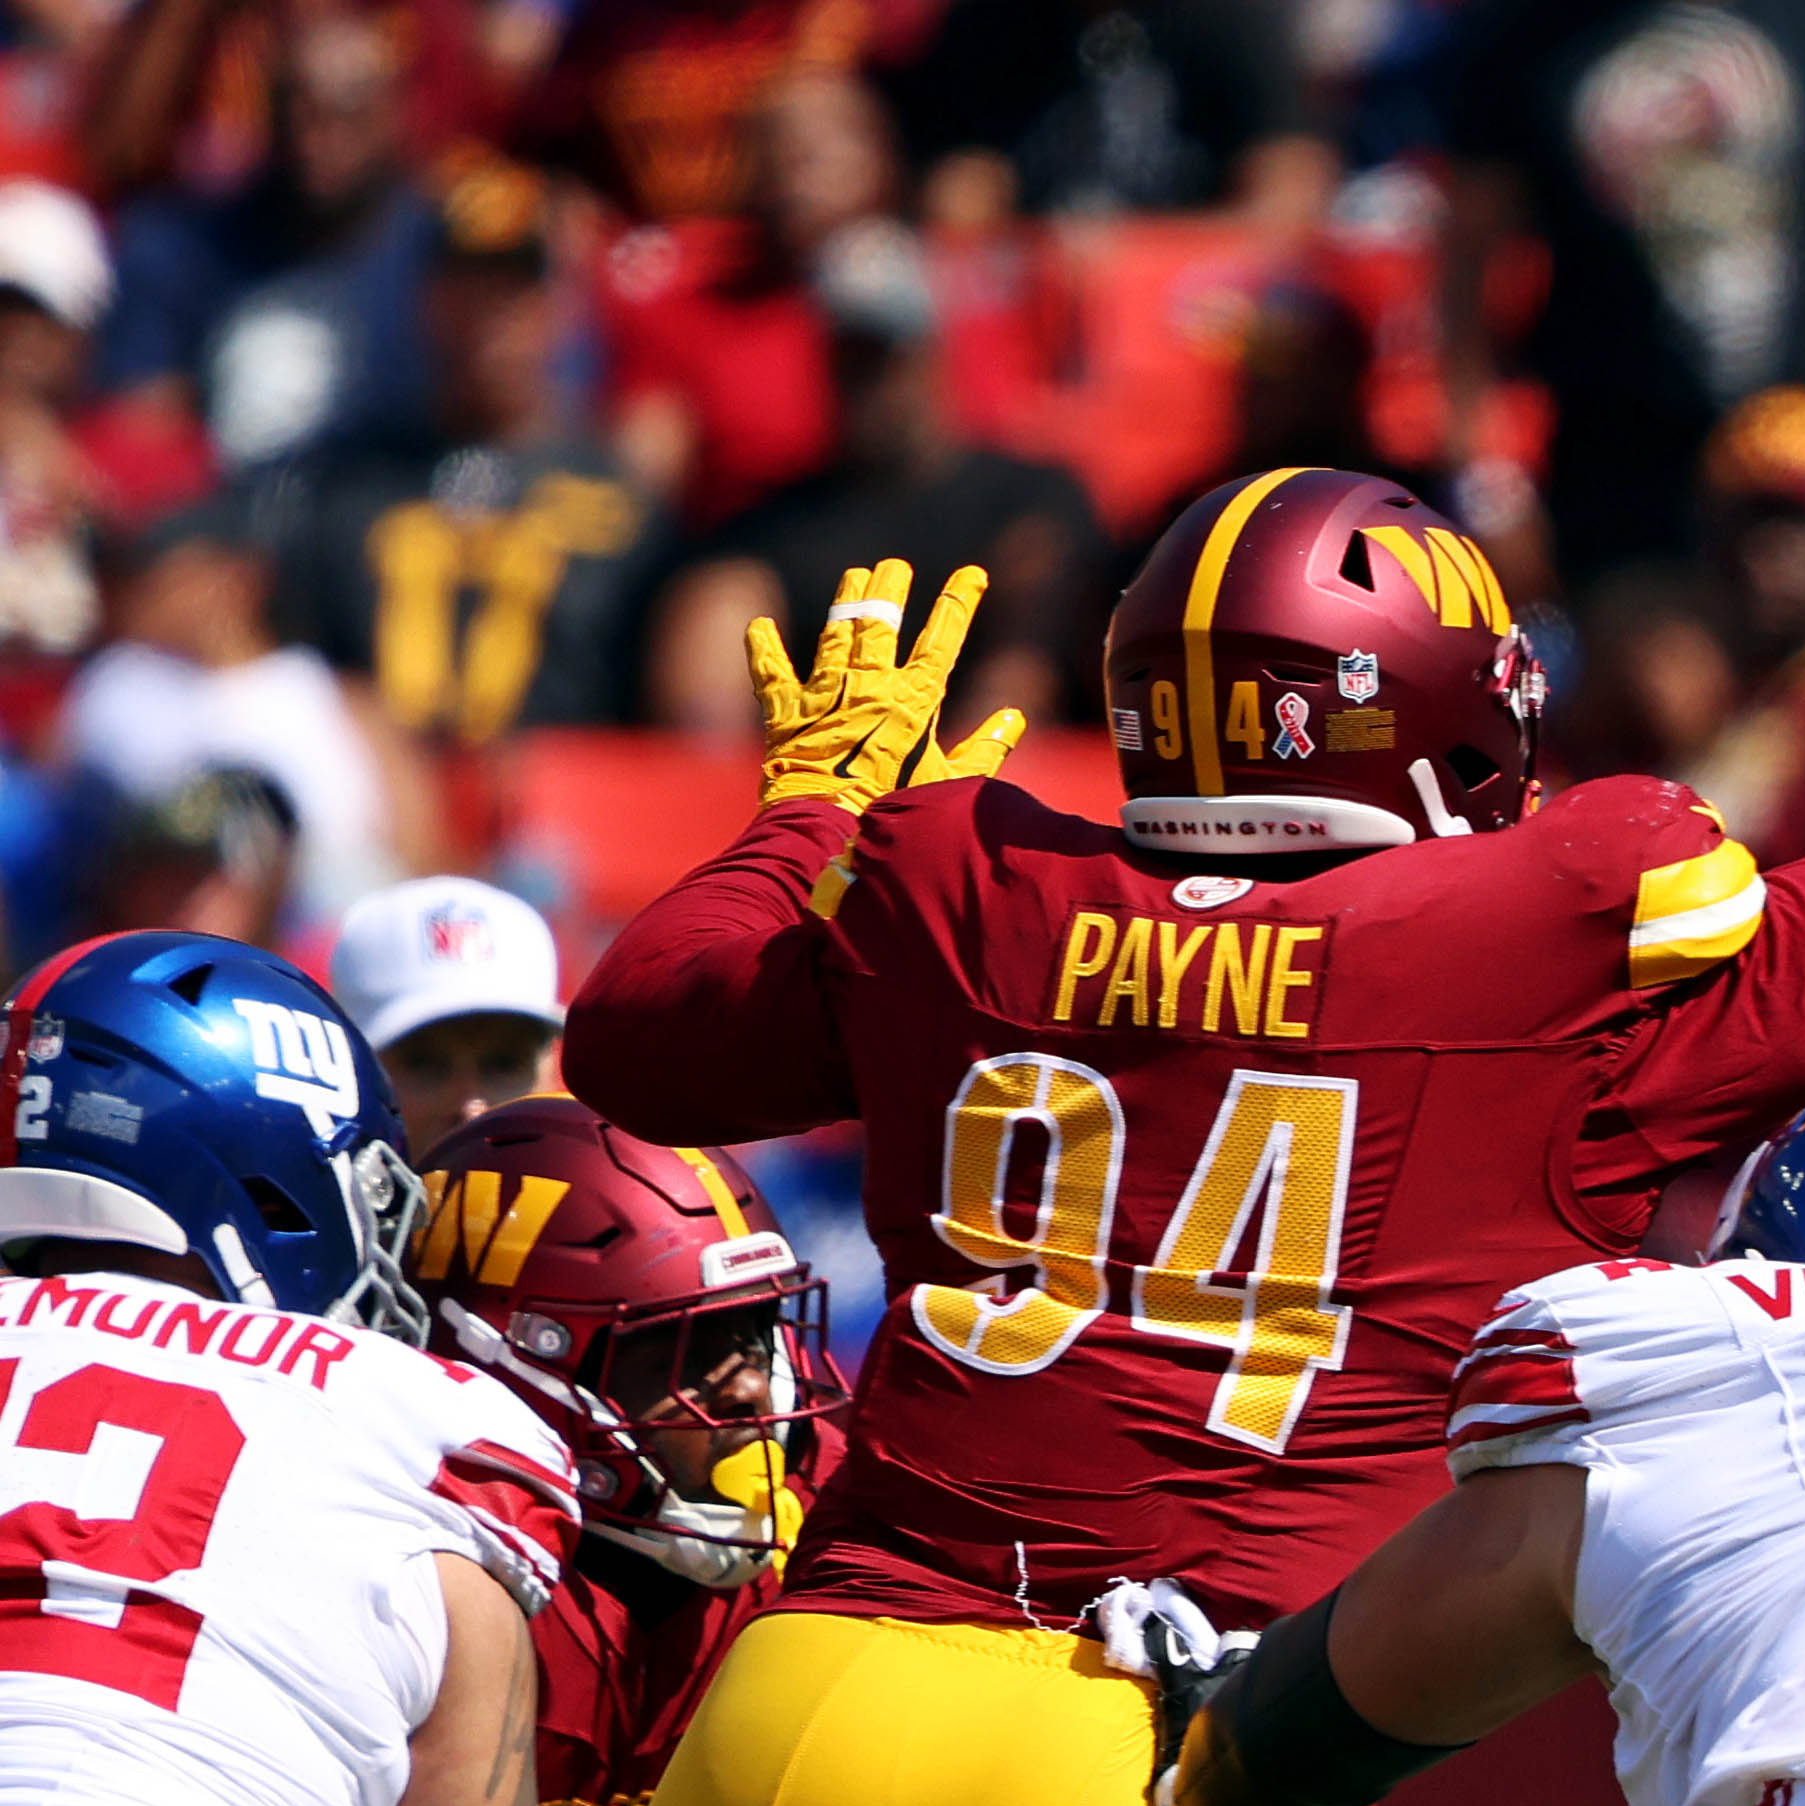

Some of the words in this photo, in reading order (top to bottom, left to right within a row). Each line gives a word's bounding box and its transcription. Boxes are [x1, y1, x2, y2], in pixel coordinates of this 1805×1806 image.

[1132, 819, 1328, 837] WASHINGTON
[1053, 911, 1323, 1039] PAYNE
[910, 1051, 1359, 1456] 94
[0, 1276, 356, 1392] MUNOR
[0, 1356, 247, 1714] 2
